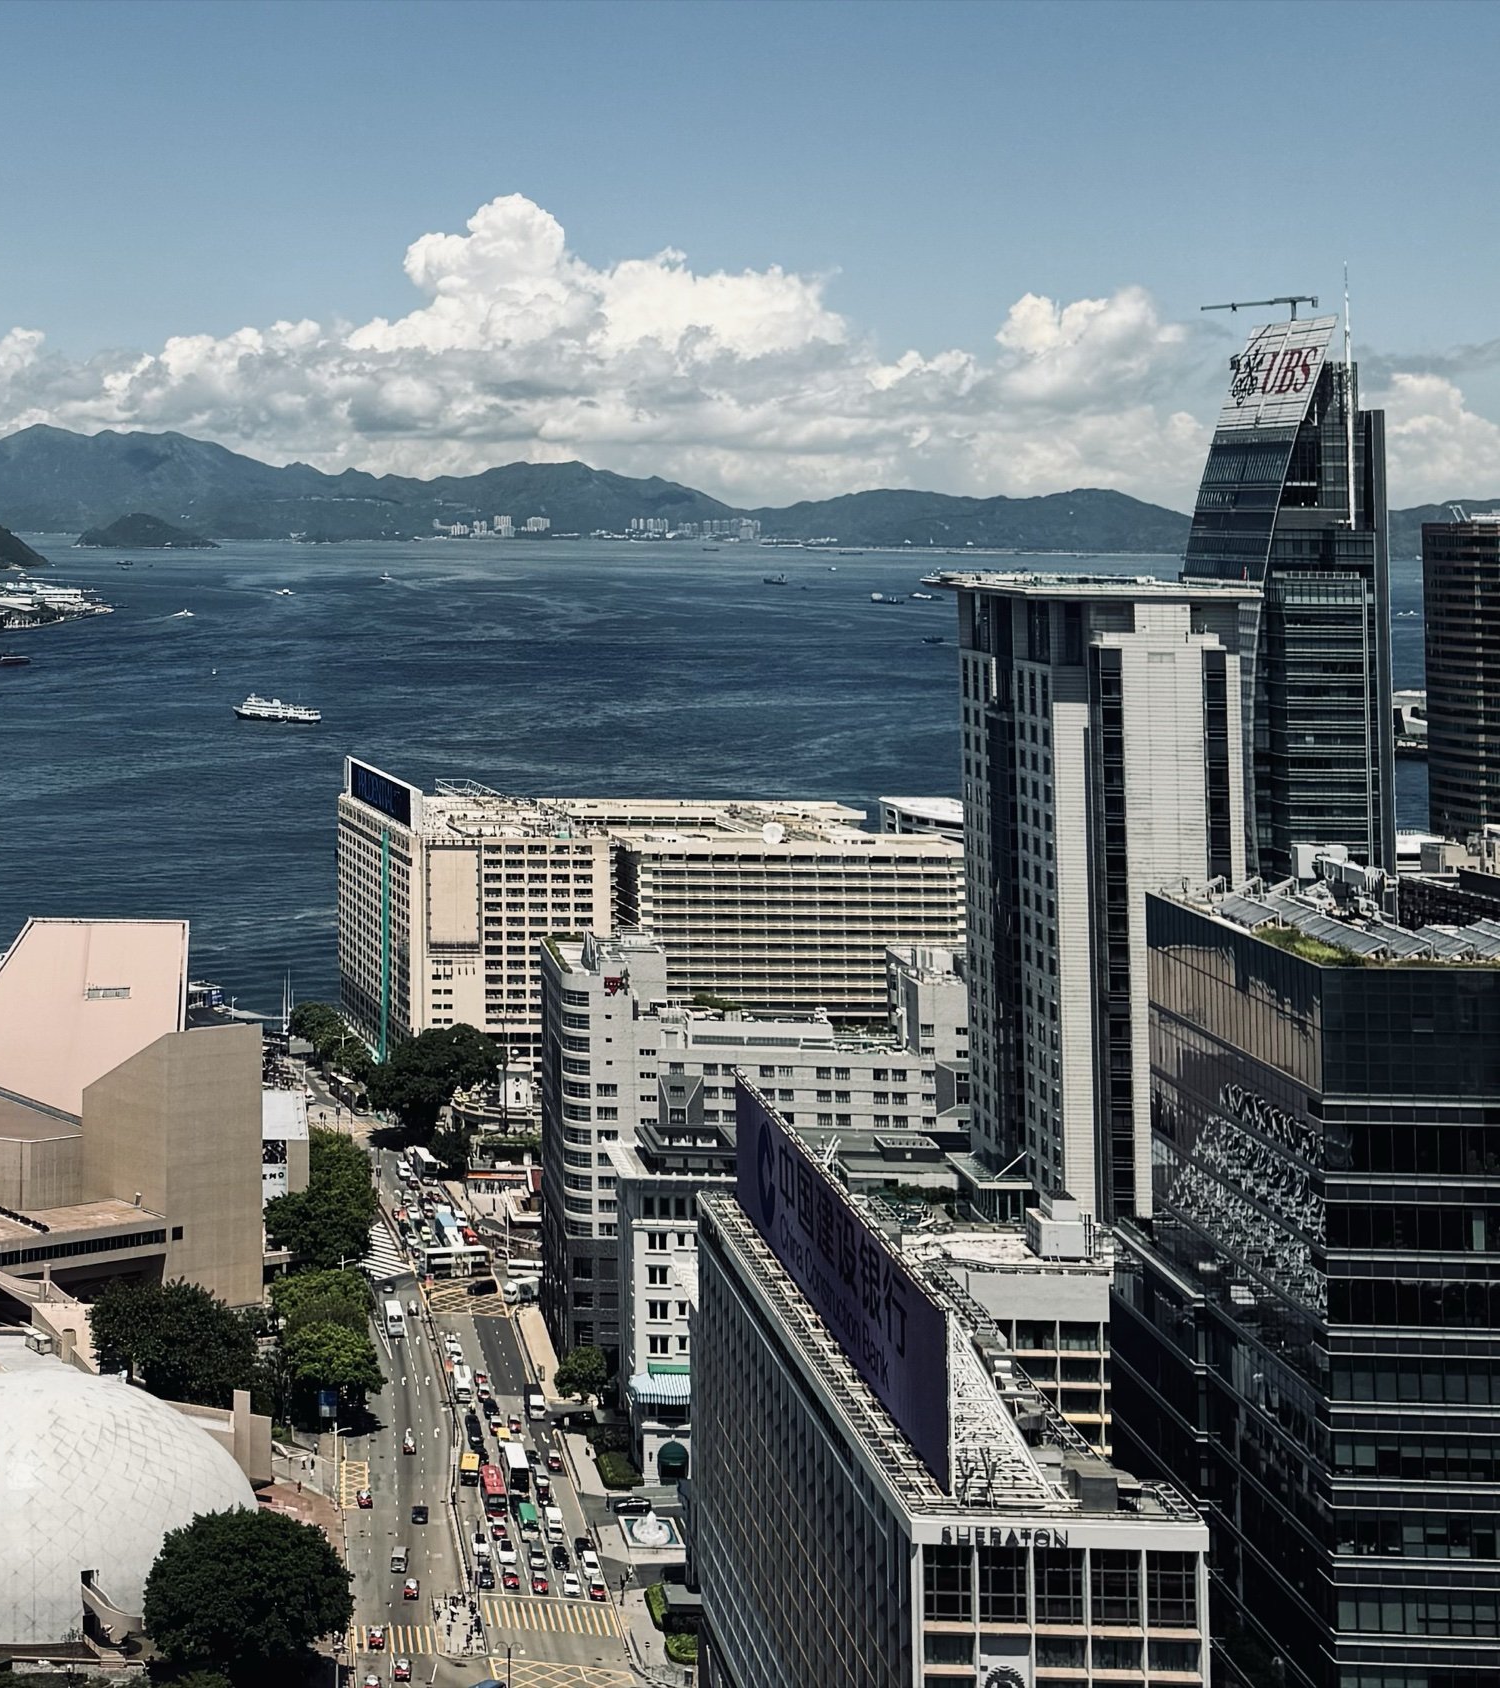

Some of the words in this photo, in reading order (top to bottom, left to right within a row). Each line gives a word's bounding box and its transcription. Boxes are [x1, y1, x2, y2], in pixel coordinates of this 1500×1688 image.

[1261, 347, 1318, 394] UBS
[778, 1144, 908, 1358] 中国建设银行
[779, 1213, 804, 1276] China
[804, 1256, 861, 1349] Construction
[861, 1319, 890, 1393] Bank
[941, 1525, 1068, 1548] SHERATON
